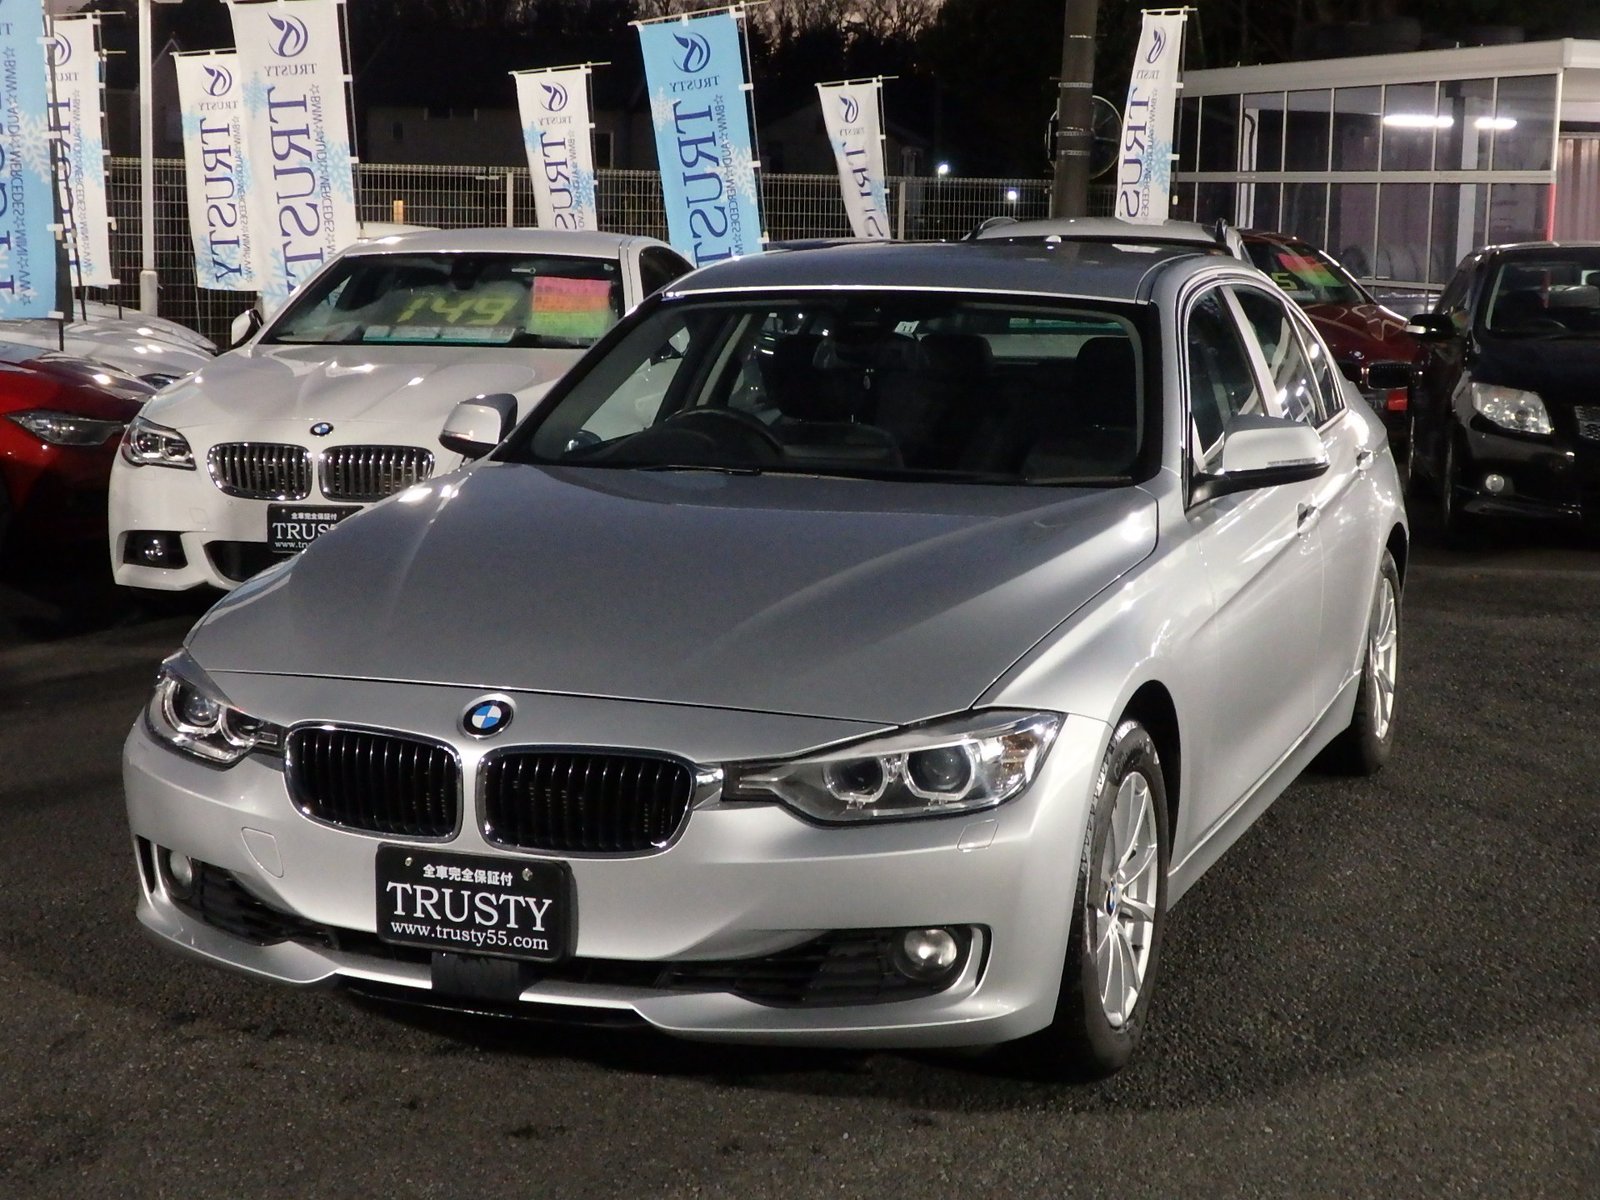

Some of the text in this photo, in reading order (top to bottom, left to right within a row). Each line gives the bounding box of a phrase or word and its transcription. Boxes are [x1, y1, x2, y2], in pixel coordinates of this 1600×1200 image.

[423, 863, 513, 887] 全車完全保証付
[386, 881, 553, 932] TRUSTY
[391, 921, 549, 950] www.trusty55.com
